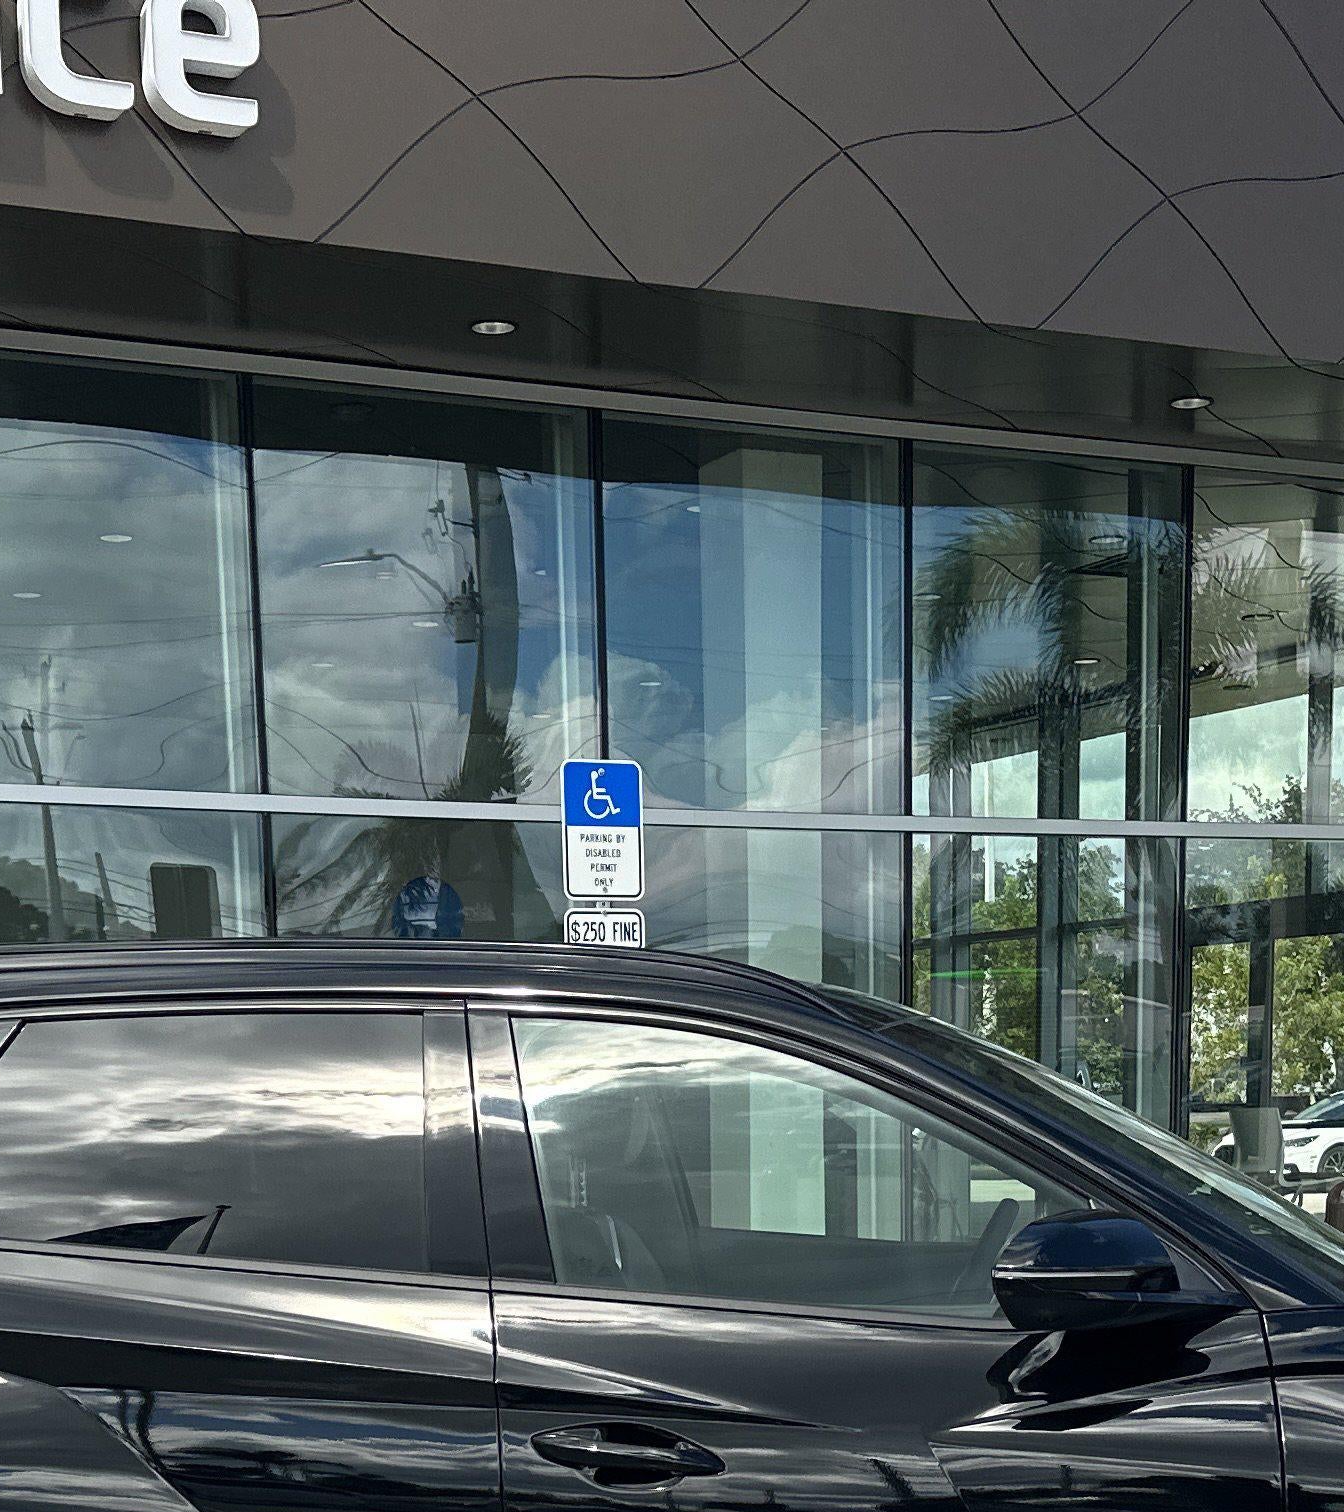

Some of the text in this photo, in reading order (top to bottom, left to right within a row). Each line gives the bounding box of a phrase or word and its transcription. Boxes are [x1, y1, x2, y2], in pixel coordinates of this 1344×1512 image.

[580, 833, 626, 843] PARKING BY
[585, 849, 621, 858] DISABLED
[590, 863, 618, 873] PERMIT
[594, 878, 614, 888] ONLY
[571, 920, 638, 943] $250 FINE
